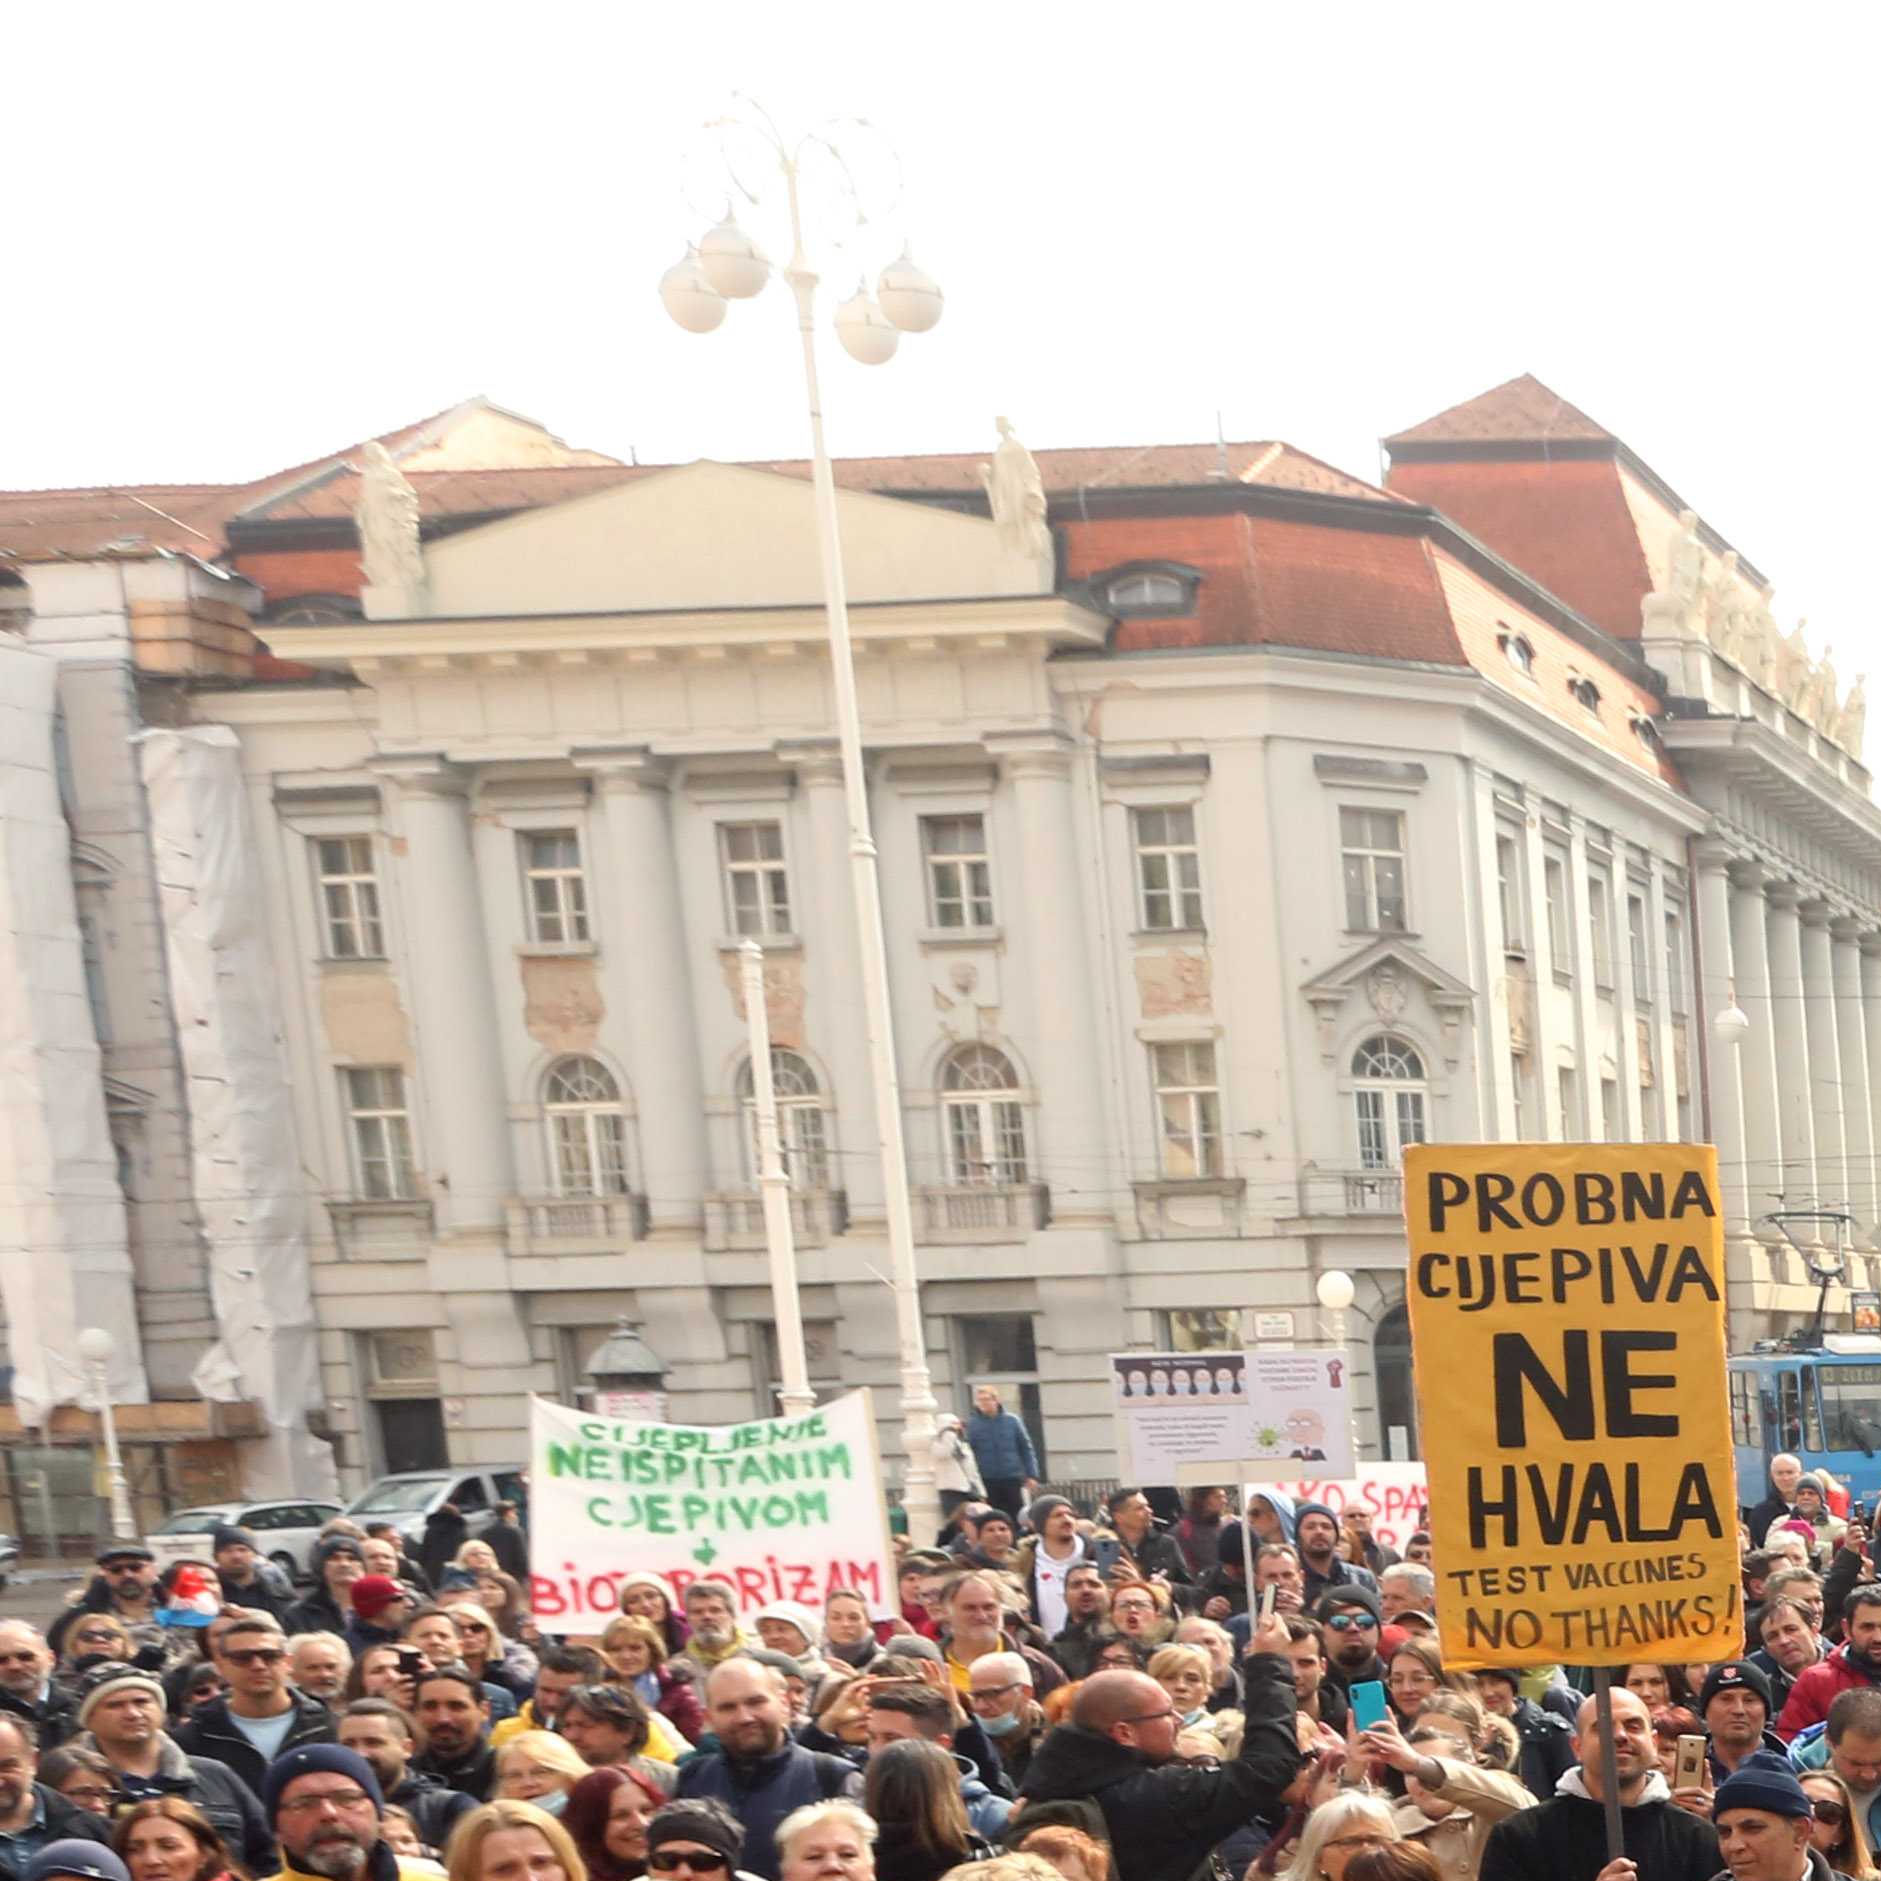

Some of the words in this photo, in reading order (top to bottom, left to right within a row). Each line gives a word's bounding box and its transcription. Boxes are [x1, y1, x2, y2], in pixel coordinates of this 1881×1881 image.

[1428, 1171, 1716, 1233] PROBNA
[1418, 1244, 1721, 1312] CIJEPIVA
[1494, 1329, 1680, 1447] NE
[548, 1442, 852, 1489] NEISPITANIM
[587, 1490, 829, 1534] CJEPIVOM
[1467, 1462, 1723, 1549] HVALA
[1448, 1563, 1553, 1598] TEST
[1563, 1552, 1707, 1591] VACCINES
[1467, 1605, 1543, 1651] NO
[1550, 1584, 1737, 1650] THANKS!
